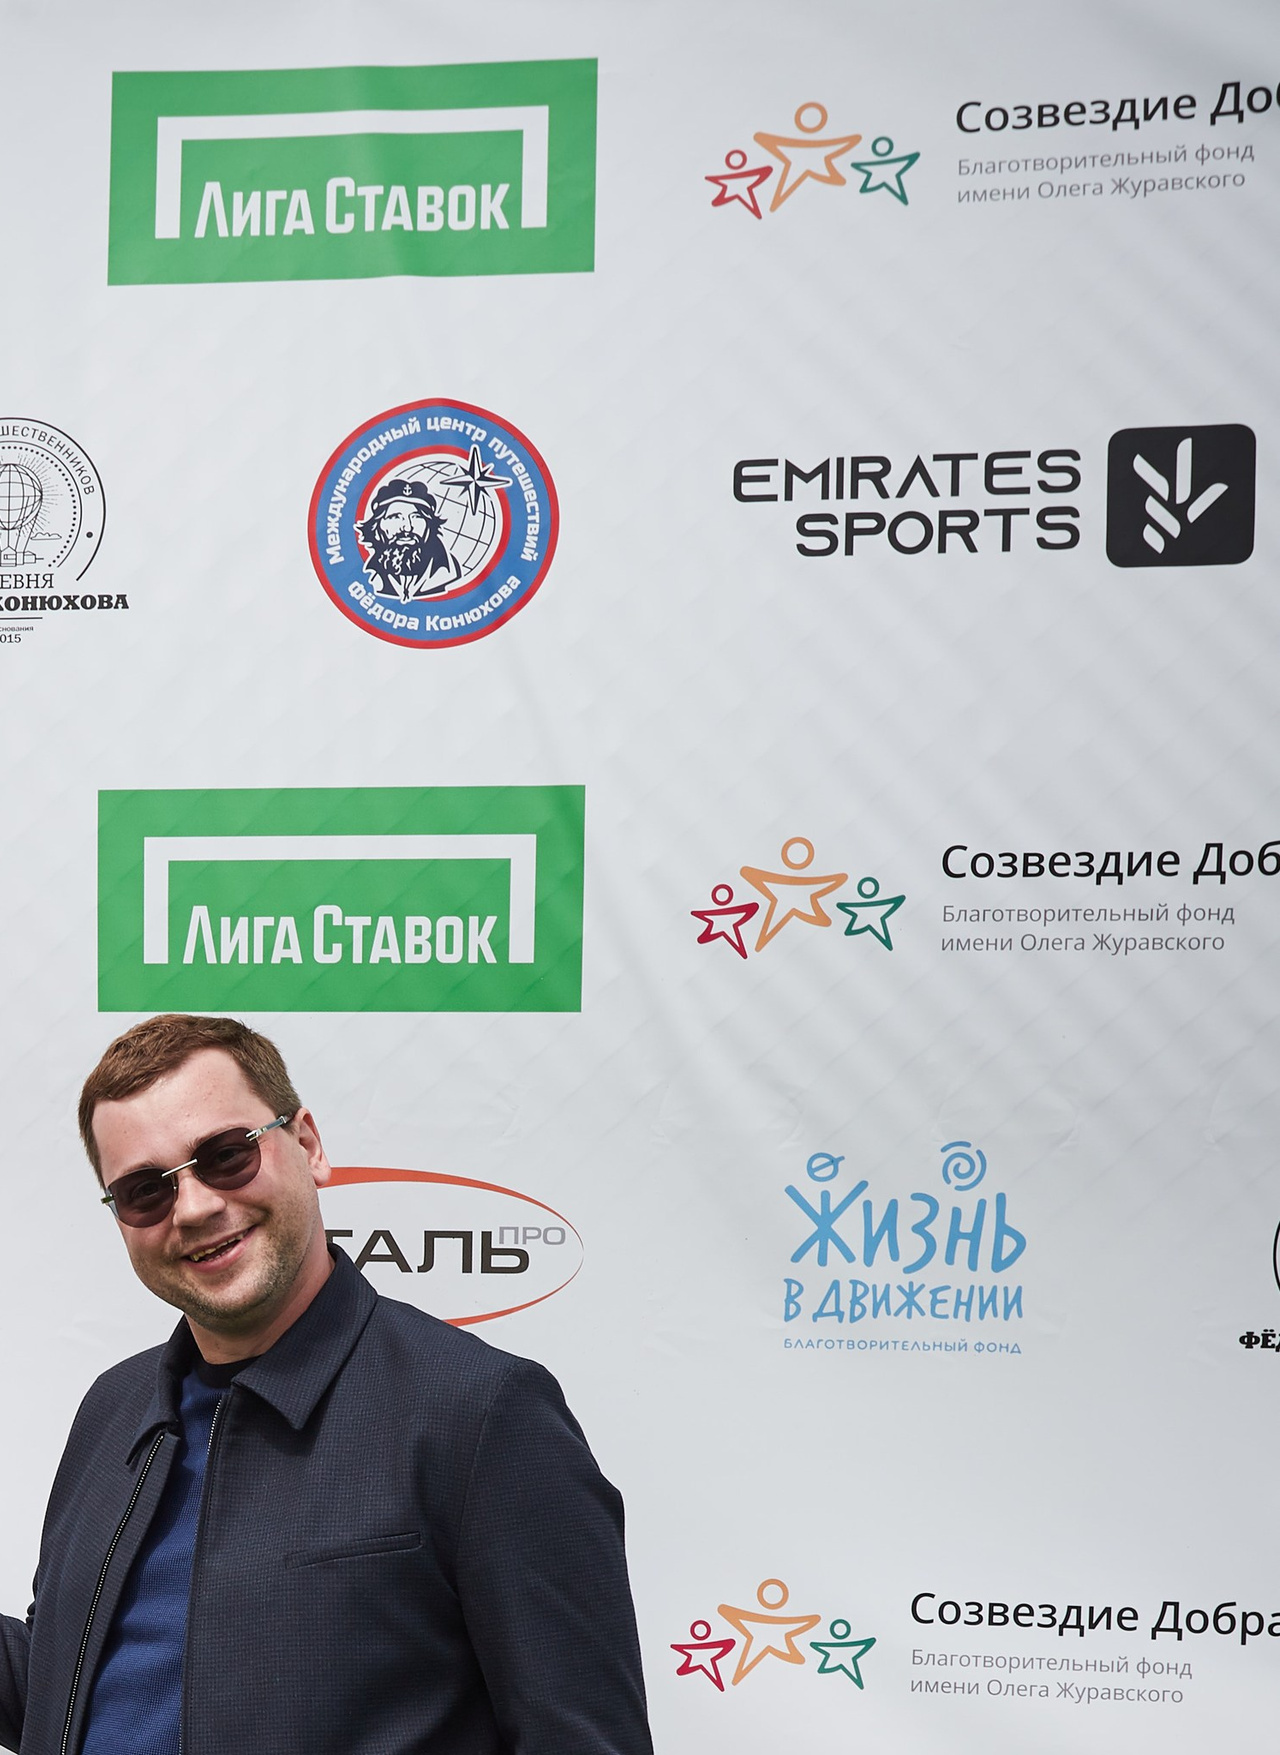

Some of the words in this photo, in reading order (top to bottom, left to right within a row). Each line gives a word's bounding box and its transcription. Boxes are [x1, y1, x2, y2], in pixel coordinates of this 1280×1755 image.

[956, 94, 1197, 134] Созвездие
[958, 144, 1187, 176] Благотворительный
[1194, 143, 1255, 166] фонд
[957, 186, 1030, 204] имени
[1037, 181, 1103, 199] Олега
[1110, 173, 1246, 199] Журавского
[325, 415, 422, 566] Международный
[425, 415, 489, 443] центр
[487, 435, 541, 562] путешествий
[732, 448, 1082, 503] EMIRATES
[795, 505, 1081, 558] SPORTS
[346, 579, 421, 632] Фёдора
[424, 574, 522, 632] Конюхова
[942, 844, 1181, 886] Созвездие
[1192, 840, 1280, 885] Доб
[943, 902, 1169, 927] Благотворительный
[1176, 902, 1235, 927] фонд
[941, 937, 1013, 952] имени
[1020, 933, 1085, 952] Олега
[1092, 933, 1225, 956] Журавского
[324, 1228, 530, 1275] АЛЬ
[498, 1226, 566, 1246] ПРО
[811, 1279, 1023, 1324] ДВИЖЕНИИ
[783, 1338, 968, 1352] БЛАГОТВОРИТЕЛЬНЫЙ
[973, 1341, 1022, 1355] ФОНД
[911, 1592, 1139, 1638] Созвездие
[911, 1648, 1129, 1674] Благотворительный
[1136, 1656, 1193, 1680] фонд
[910, 1679, 980, 1695] имени
[986, 1679, 1049, 1698] Олега
[1056, 1681, 1184, 1705] Журавского
